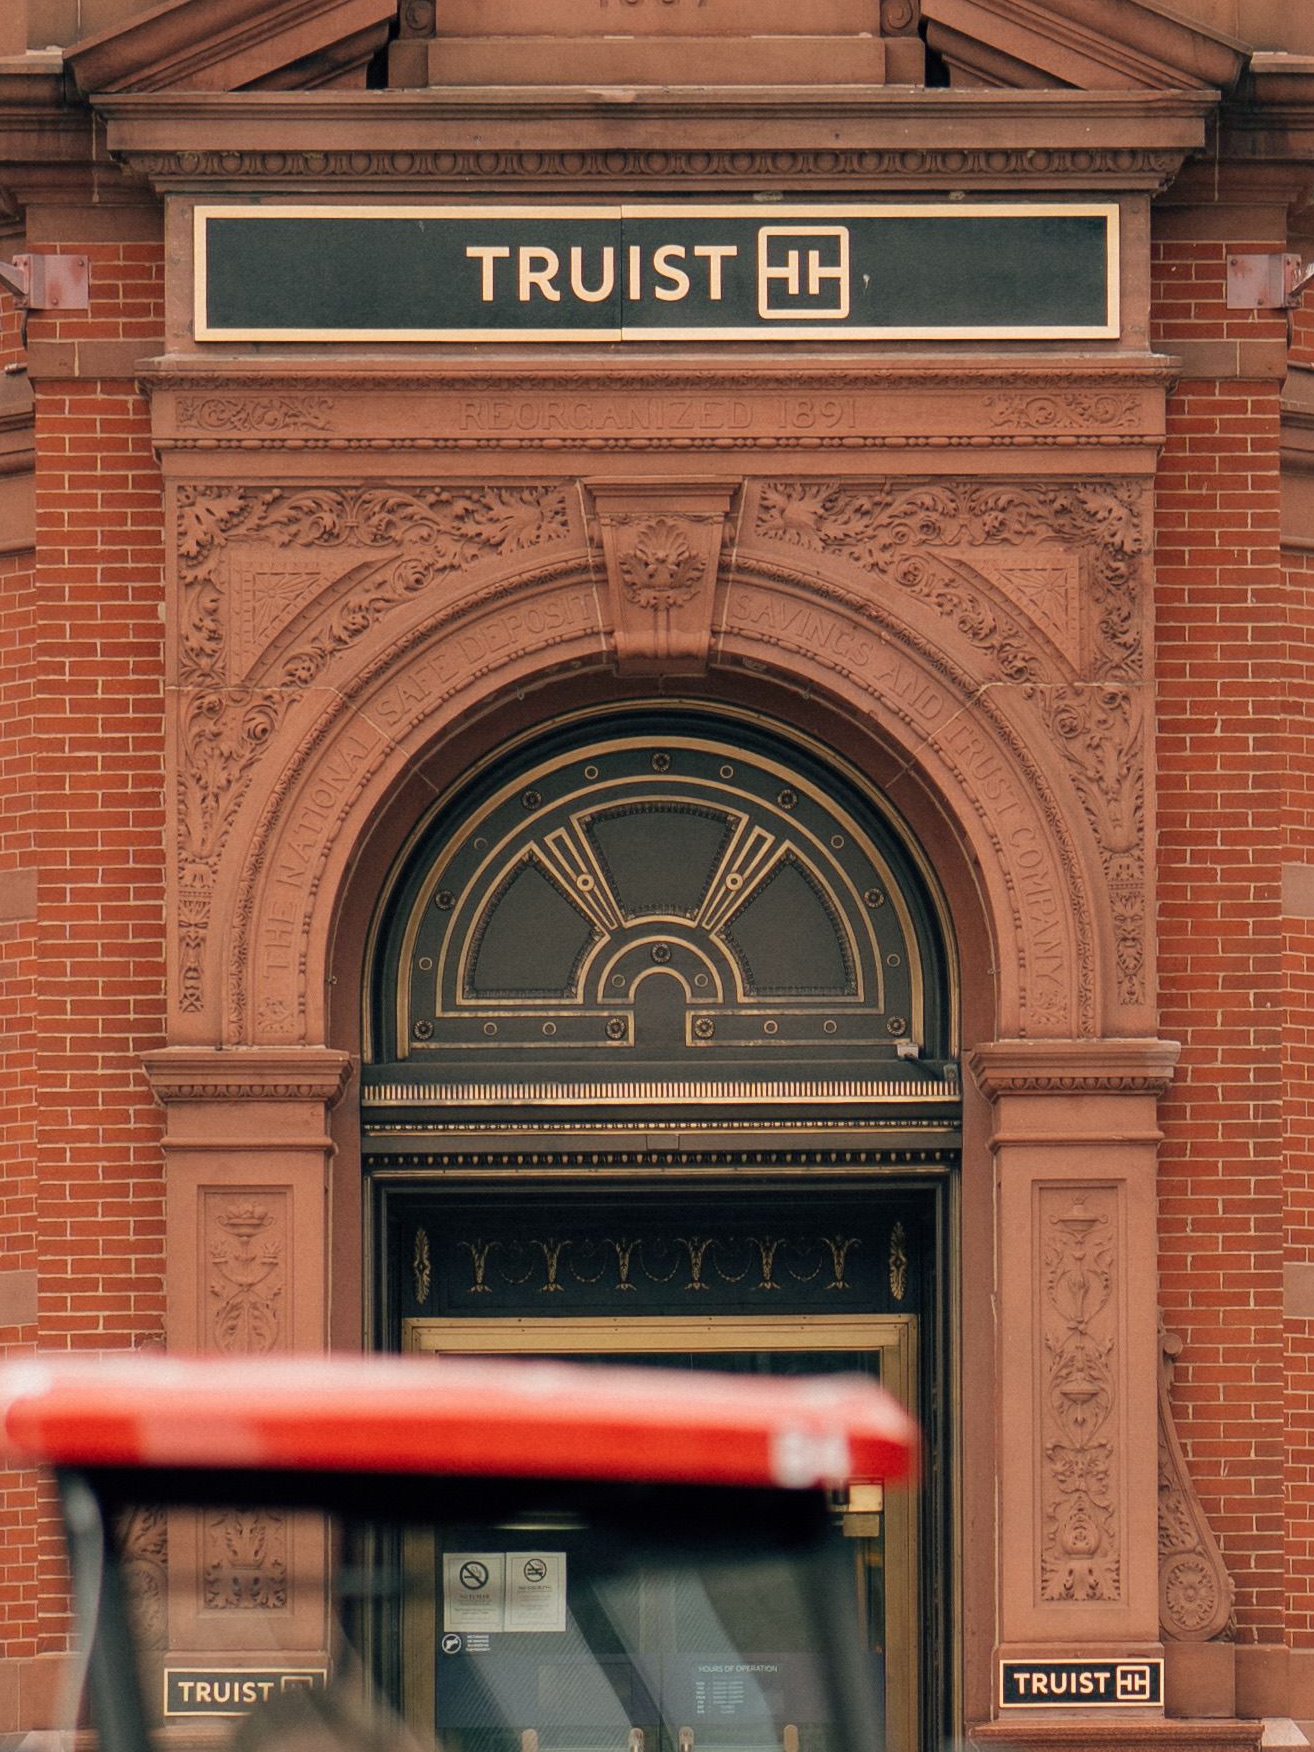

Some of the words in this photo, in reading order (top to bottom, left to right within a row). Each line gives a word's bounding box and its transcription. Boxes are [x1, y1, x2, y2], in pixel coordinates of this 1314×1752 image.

[465, 244, 738, 304] TRUIST
[459, 398, 753, 432] REORGANIZED
[776, 398, 858, 431] 1891
[458, 593, 596, 666] DEPOSIT
[731, 594, 874, 666] SAVINGS
[375, 654, 460, 727] SAFE
[876, 662, 945, 721] AND
[943, 714, 1028, 816] TRUST
[277, 735, 382, 888] NATIONAL
[262, 903, 295, 980] THE
[1008, 825, 1066, 989] COMPANY
[178, 1681, 275, 1703] TRUIST
[698, 1664, 723, 1673] HOURS
[724, 1664, 735, 1673] OF
[735, 1664, 779, 1673] OPERATION
[1013, 1672, 1111, 1695] TRUIST
